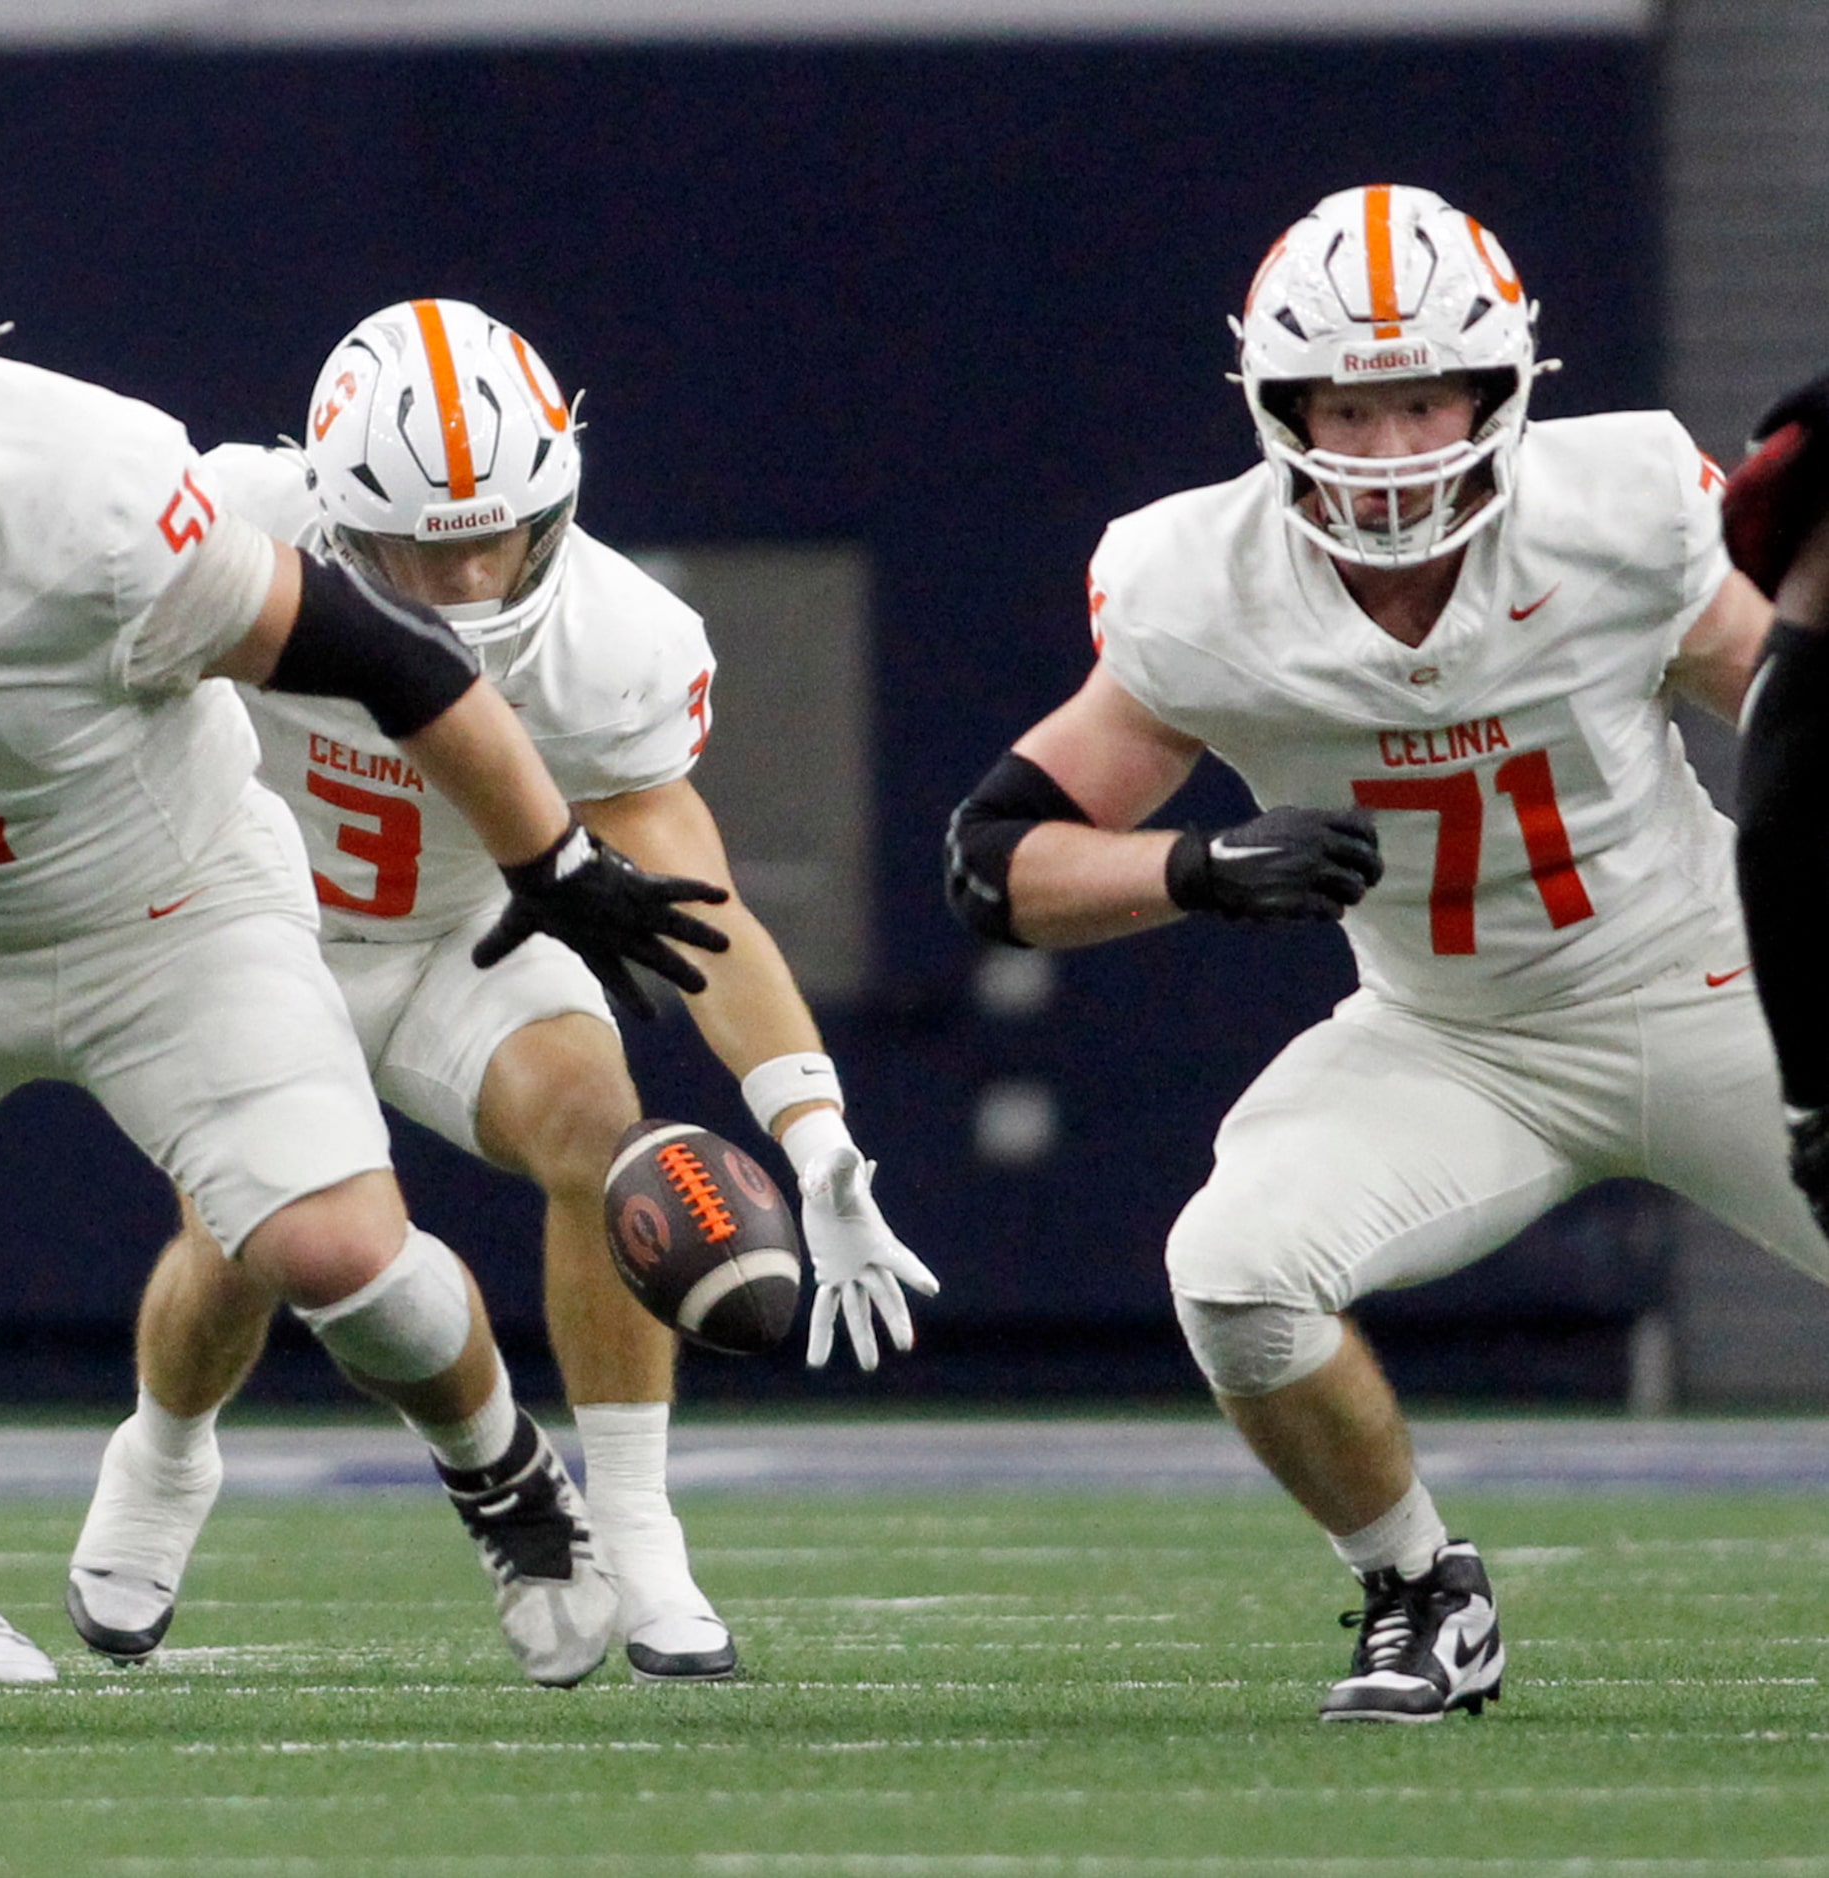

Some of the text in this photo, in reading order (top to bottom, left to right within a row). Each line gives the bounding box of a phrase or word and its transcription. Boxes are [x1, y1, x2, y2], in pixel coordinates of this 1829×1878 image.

[1344, 351, 1428, 372] Riddell
[157, 466, 216, 555] 51
[427, 507, 505, 532] Riddell
[310, 733, 424, 792] CELINA
[1379, 716, 1509, 768] CELINA
[307, 770, 423, 918] 3
[1350, 749, 1595, 955] 71
